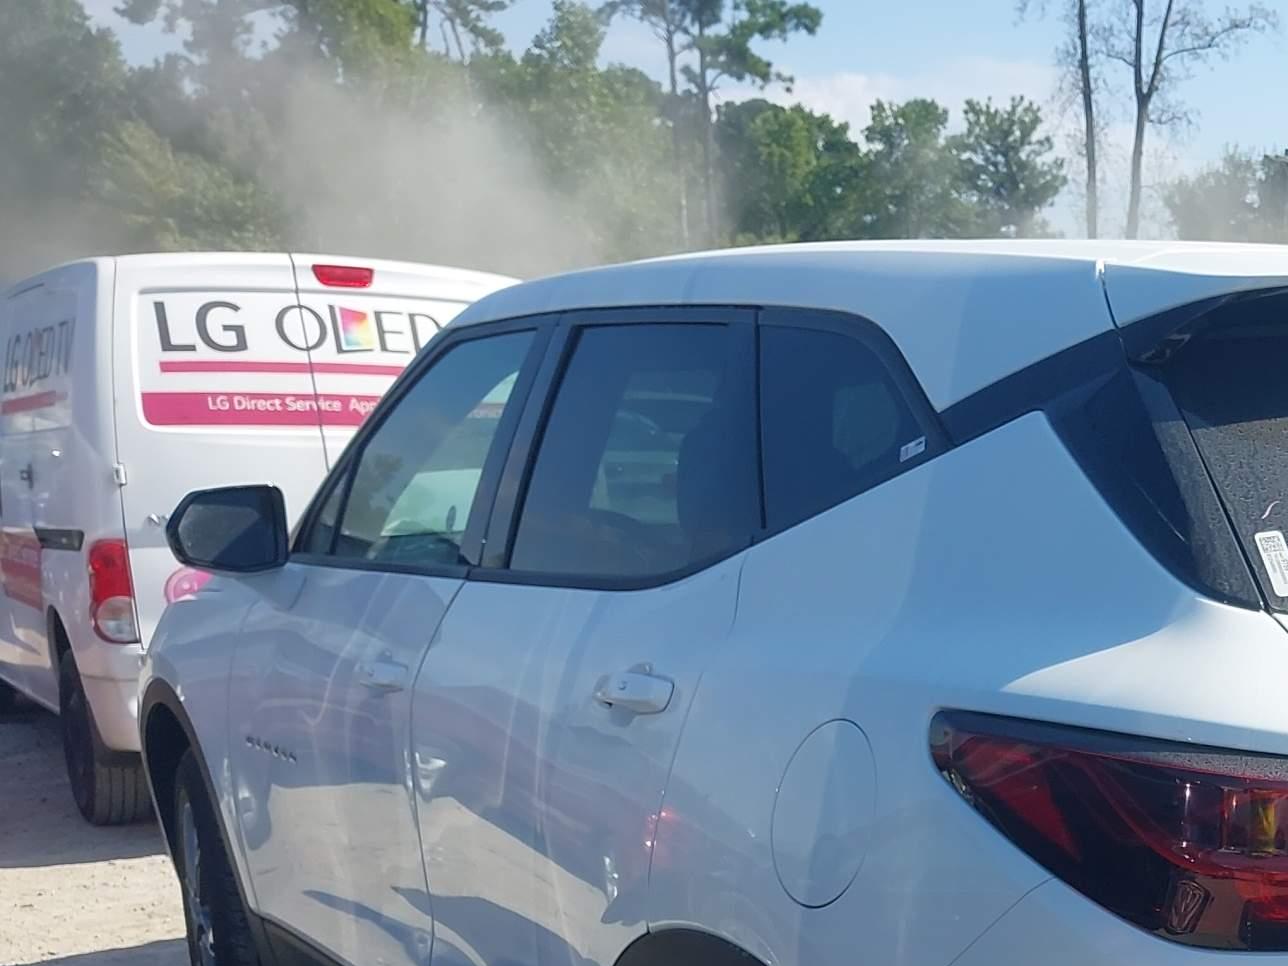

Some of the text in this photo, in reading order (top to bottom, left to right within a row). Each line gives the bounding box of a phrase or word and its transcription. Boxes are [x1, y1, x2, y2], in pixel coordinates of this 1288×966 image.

[153, 300, 248, 352] LG
[207, 395, 230, 411] LG
[233, 395, 282, 411] Direct
[285, 396, 342, 412] Service
